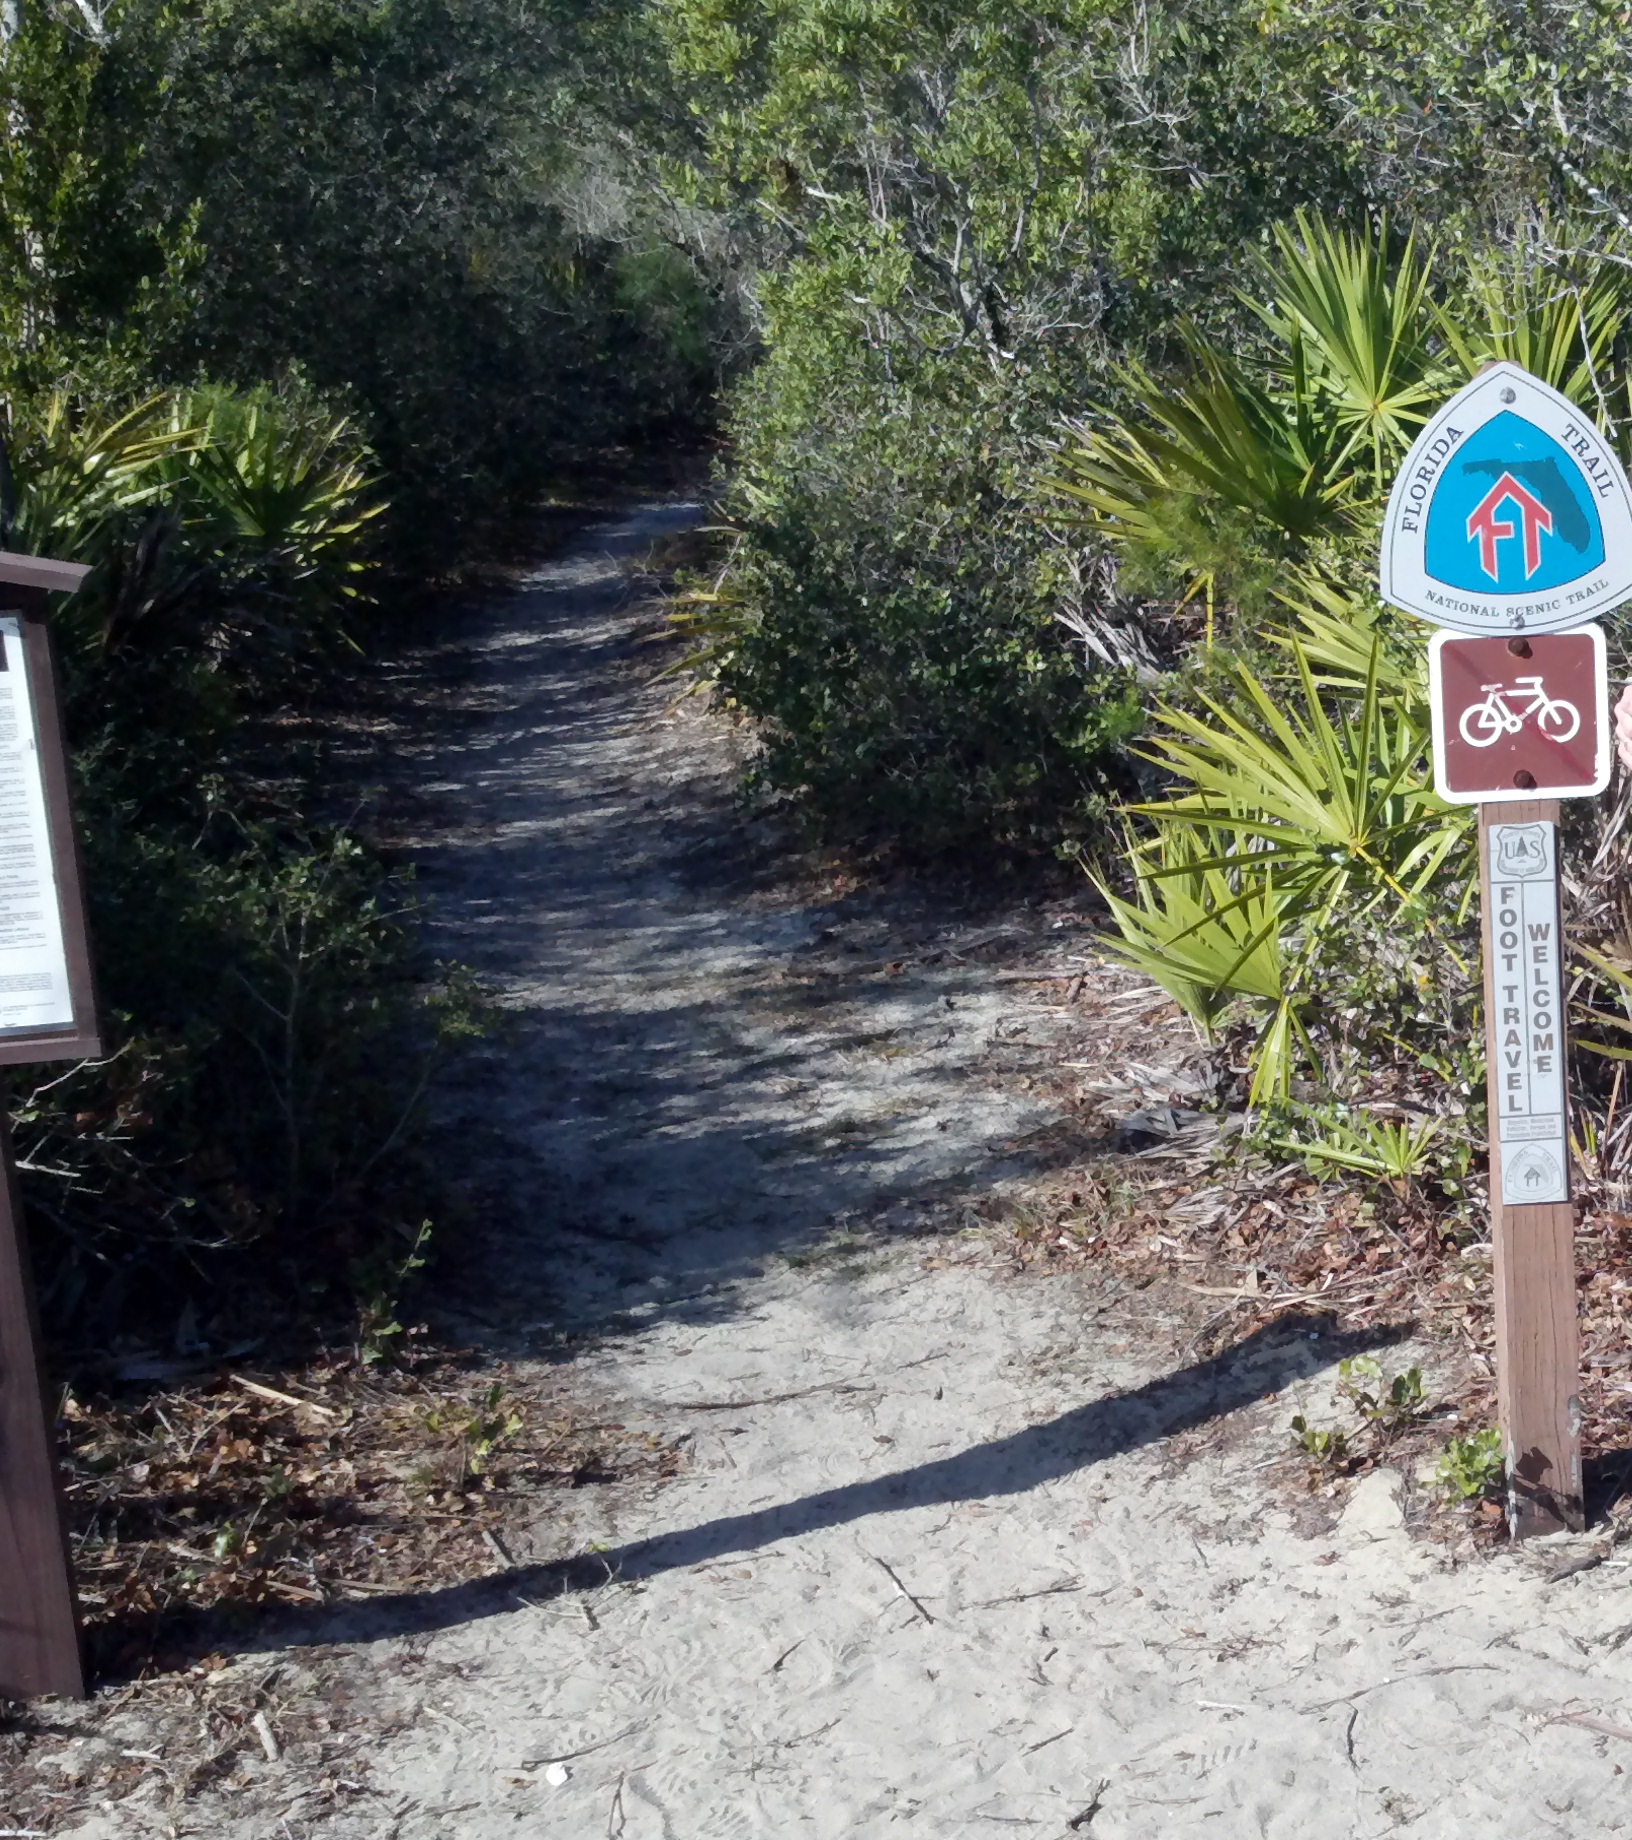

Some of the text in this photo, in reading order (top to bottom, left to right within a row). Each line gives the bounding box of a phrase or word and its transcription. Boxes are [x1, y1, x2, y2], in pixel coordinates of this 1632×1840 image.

[1401, 424, 1615, 534] FLORIDA TRAIL
[1425, 578, 1610, 618] NATIONAL SCENIC TRAIL
[1499, 886, 1523, 1113] FOOT TRAVEL
[1527, 922, 1554, 1073] WELCOME
